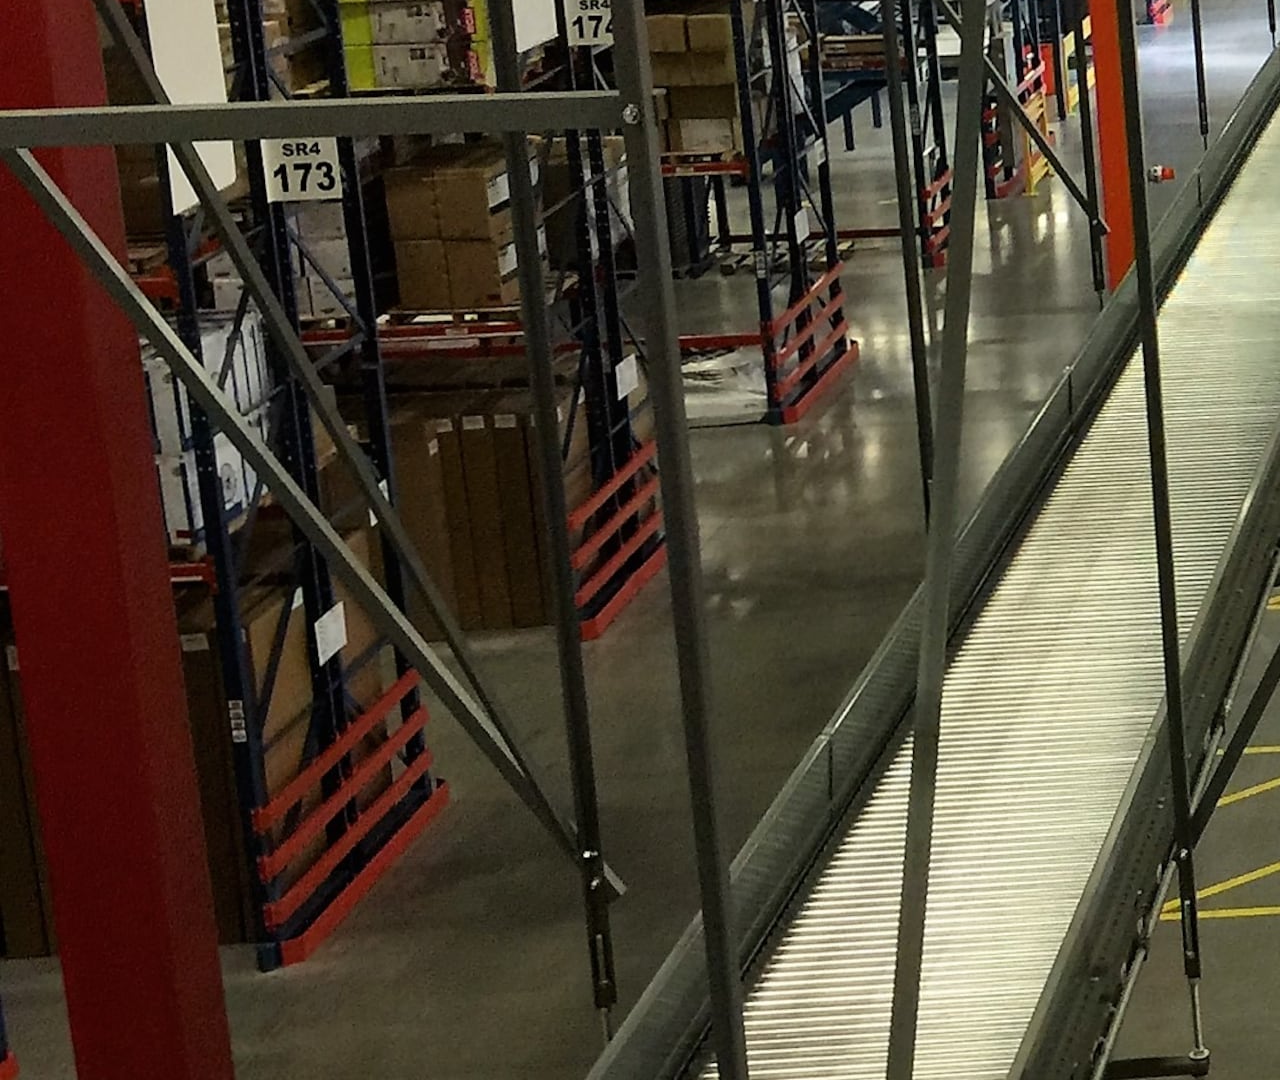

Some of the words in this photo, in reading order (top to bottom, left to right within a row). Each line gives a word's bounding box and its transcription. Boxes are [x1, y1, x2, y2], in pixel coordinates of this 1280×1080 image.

[579, 0, 611, 10] SR4
[282, 142, 321, 157] SR4
[273, 161, 336, 193] 173
